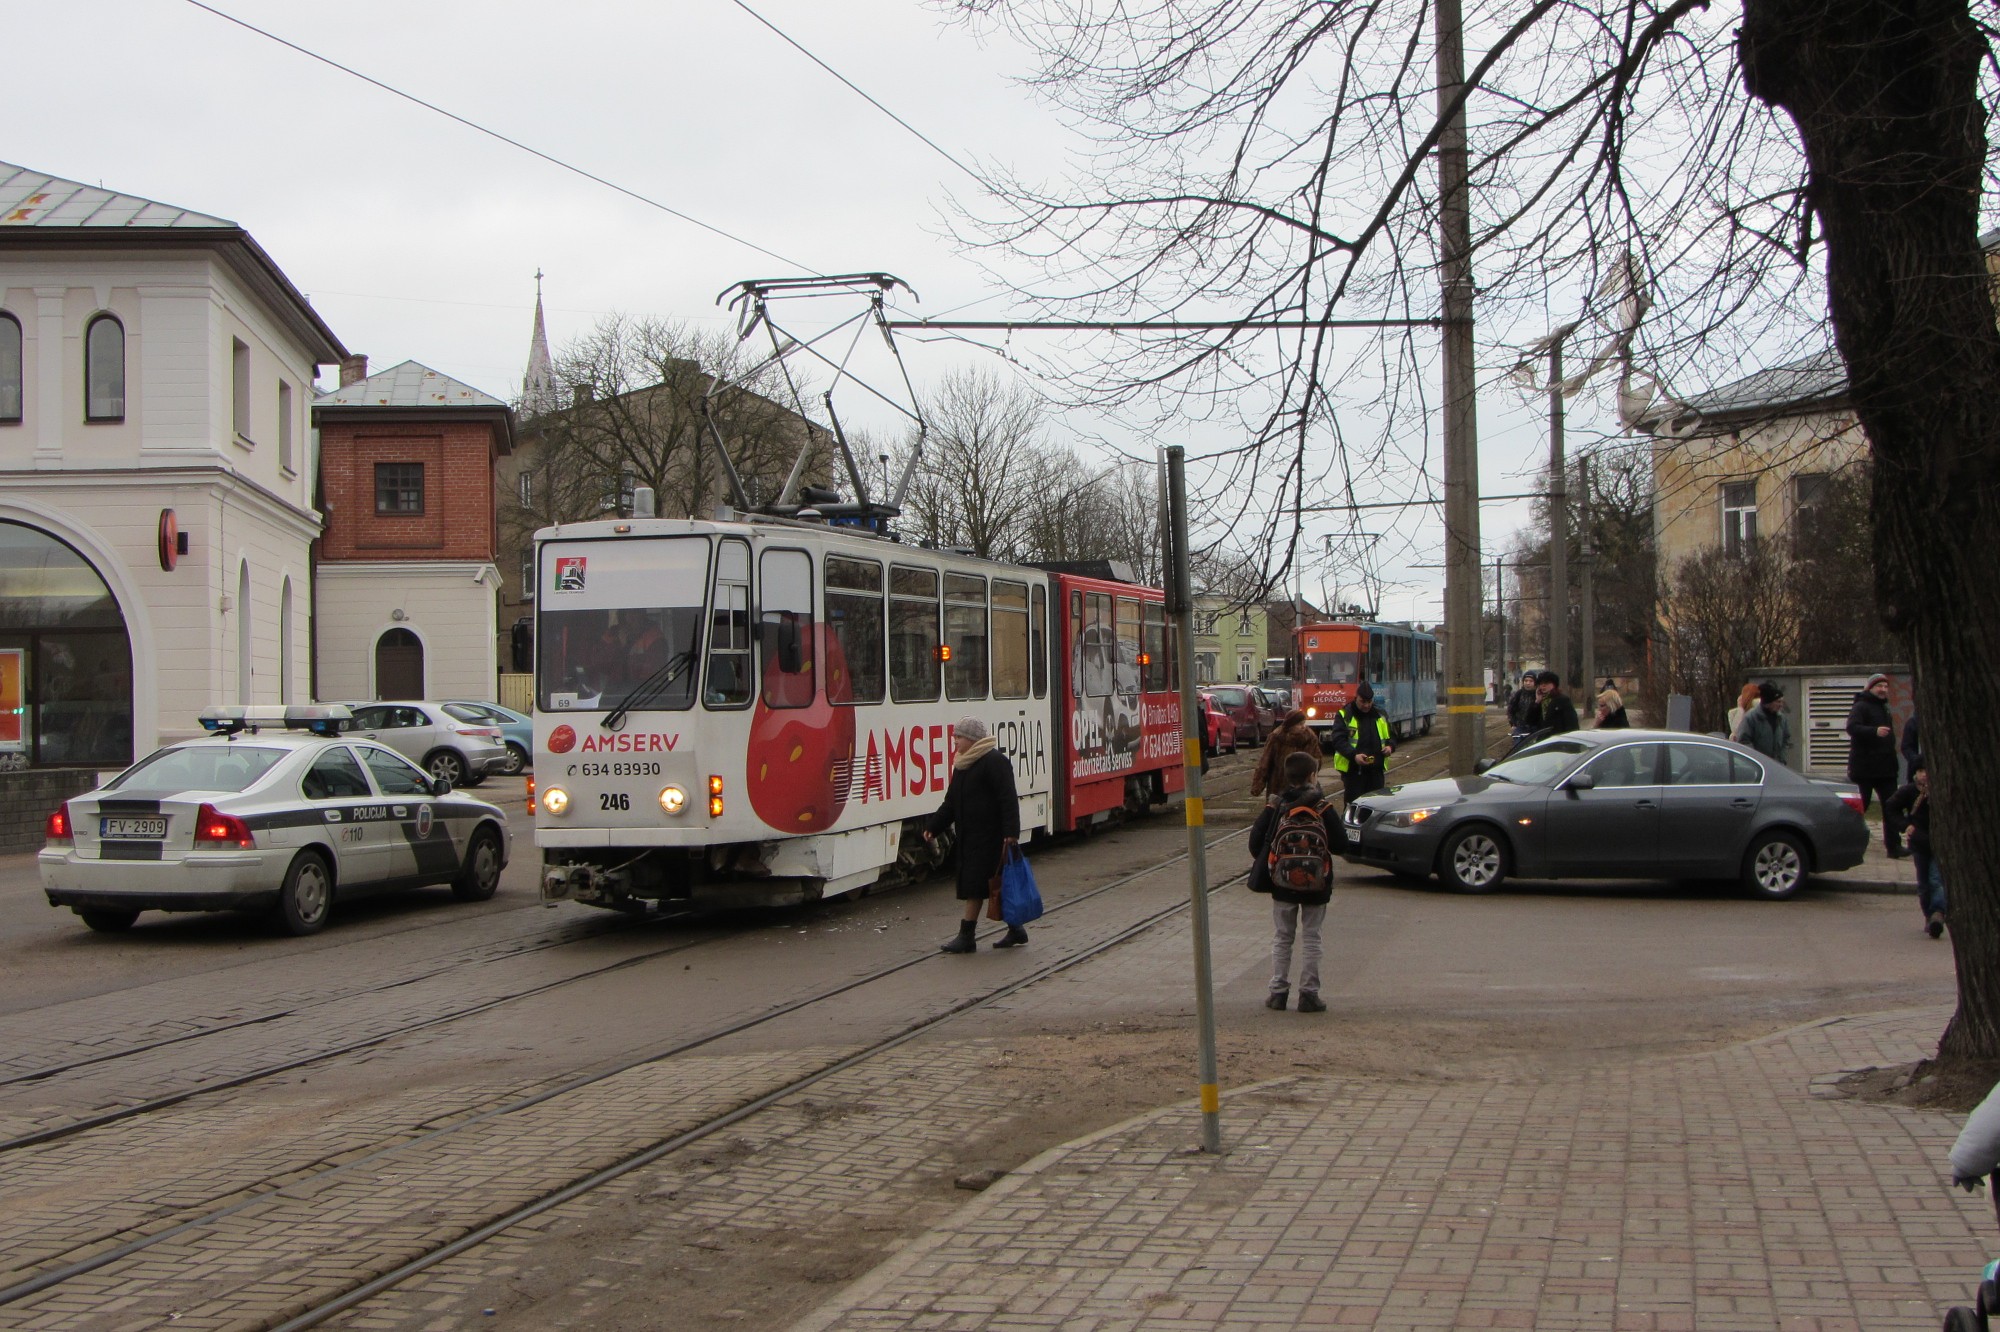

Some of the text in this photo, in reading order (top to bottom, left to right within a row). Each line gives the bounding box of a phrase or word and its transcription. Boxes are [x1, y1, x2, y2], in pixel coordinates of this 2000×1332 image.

[558, 699, 570, 708] 69
[1072, 709, 1102, 751] OPEL
[581, 733, 680, 752] AMSERV
[582, 762, 661, 776] 634 83930
[599, 793, 630, 811] 246
[353, 806, 387, 820] POLICIJA
[109, 820, 164, 833] FV-2909
[349, 827, 363, 841] 110
